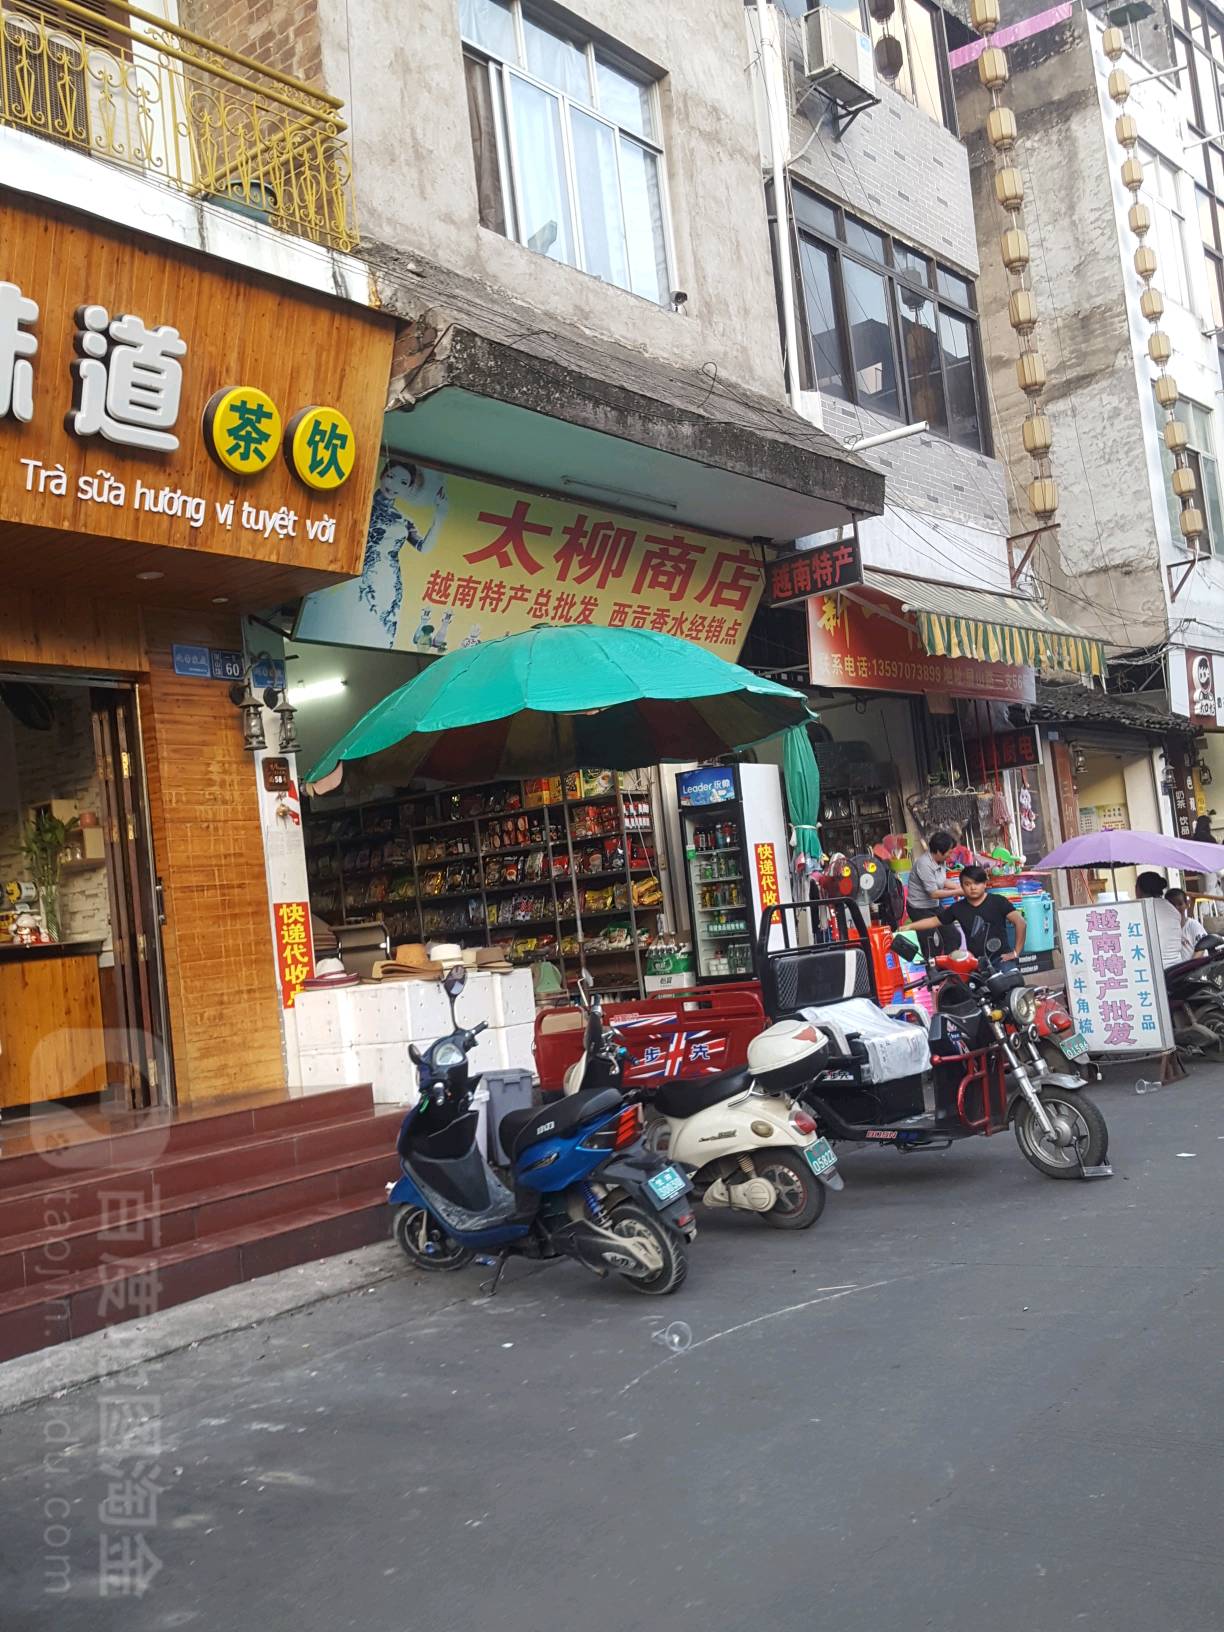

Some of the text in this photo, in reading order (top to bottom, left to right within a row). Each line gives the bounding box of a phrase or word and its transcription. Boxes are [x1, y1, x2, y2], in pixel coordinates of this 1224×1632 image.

[225, 398, 349, 483] 茶饮
[20, 458, 337, 544] Trà sữa hương vị tuyệt vời
[463, 500, 768, 612] 太柳商店
[771, 545, 855, 599] 越南特产
[422, 569, 744, 646] 越南特产总批发 西贡香水经销点
[225, 663, 240, 676] 60
[682, 781, 712, 795] Leader
[1065, 929, 1094, 1035] 香水 牛角梳
[1086, 908, 1137, 1046] 越南特产批发
[1127, 922, 1156, 1031] 红木工艺品
